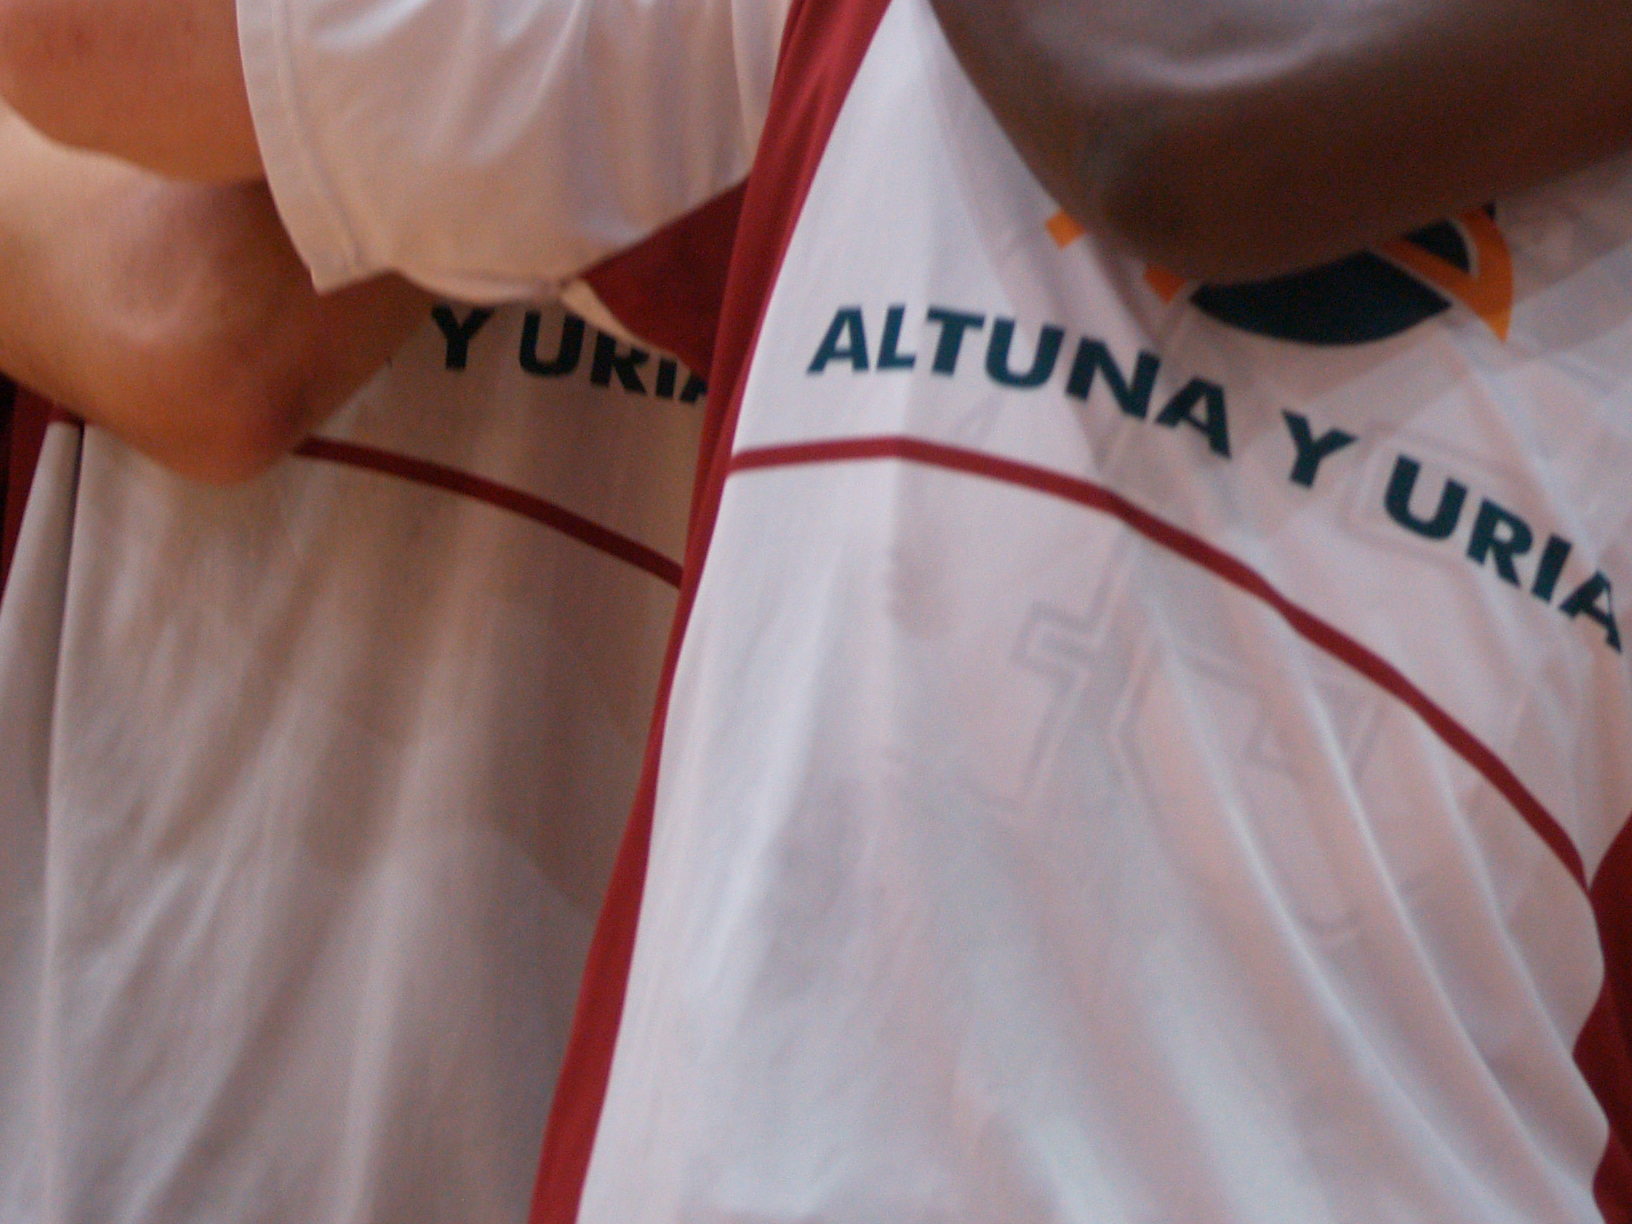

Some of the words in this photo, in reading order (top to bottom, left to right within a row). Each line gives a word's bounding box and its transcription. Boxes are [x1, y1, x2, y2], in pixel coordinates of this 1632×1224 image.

[431, 305, 495, 369] Y
[806, 303, 1233, 459] ALTUNA
[1280, 409, 1355, 488] Y
[1383, 453, 1623, 654] URIA
